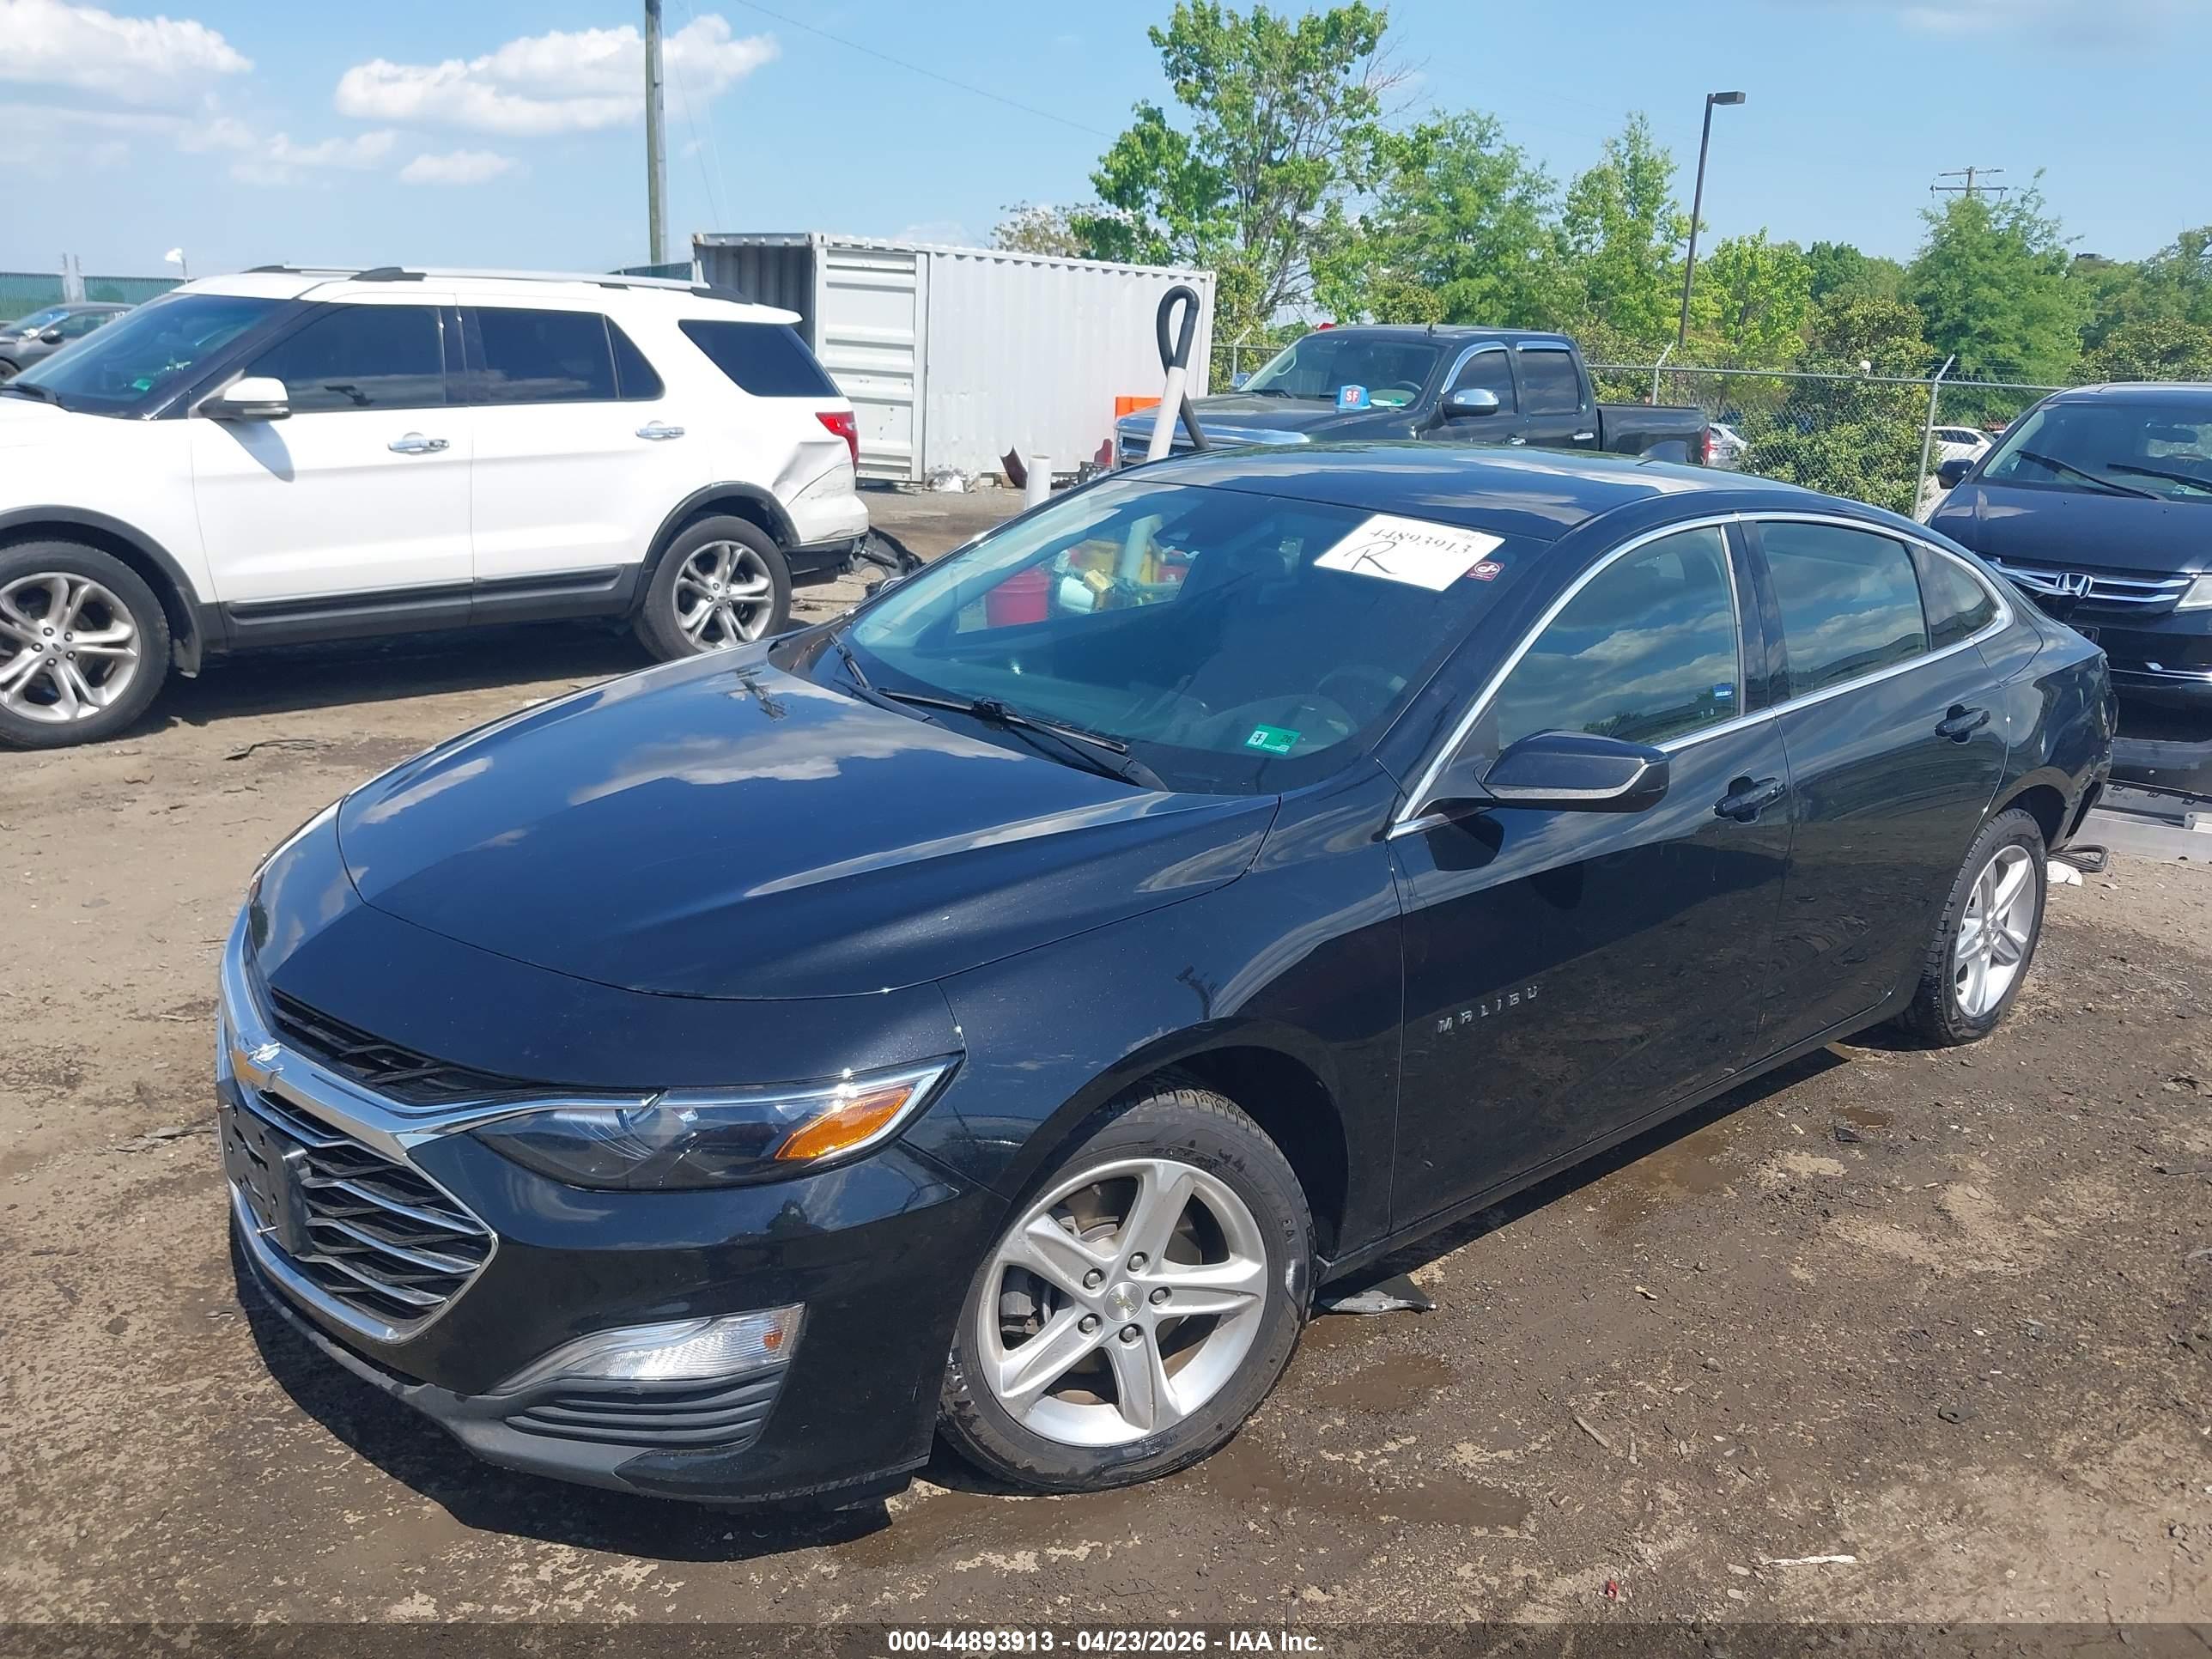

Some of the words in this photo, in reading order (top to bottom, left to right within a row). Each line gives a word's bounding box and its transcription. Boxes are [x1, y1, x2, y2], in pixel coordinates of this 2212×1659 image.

[1344, 540, 1398, 574] R
[1370, 527, 1473, 555] 44893913
[1437, 985, 1539, 1033] MALIBU
